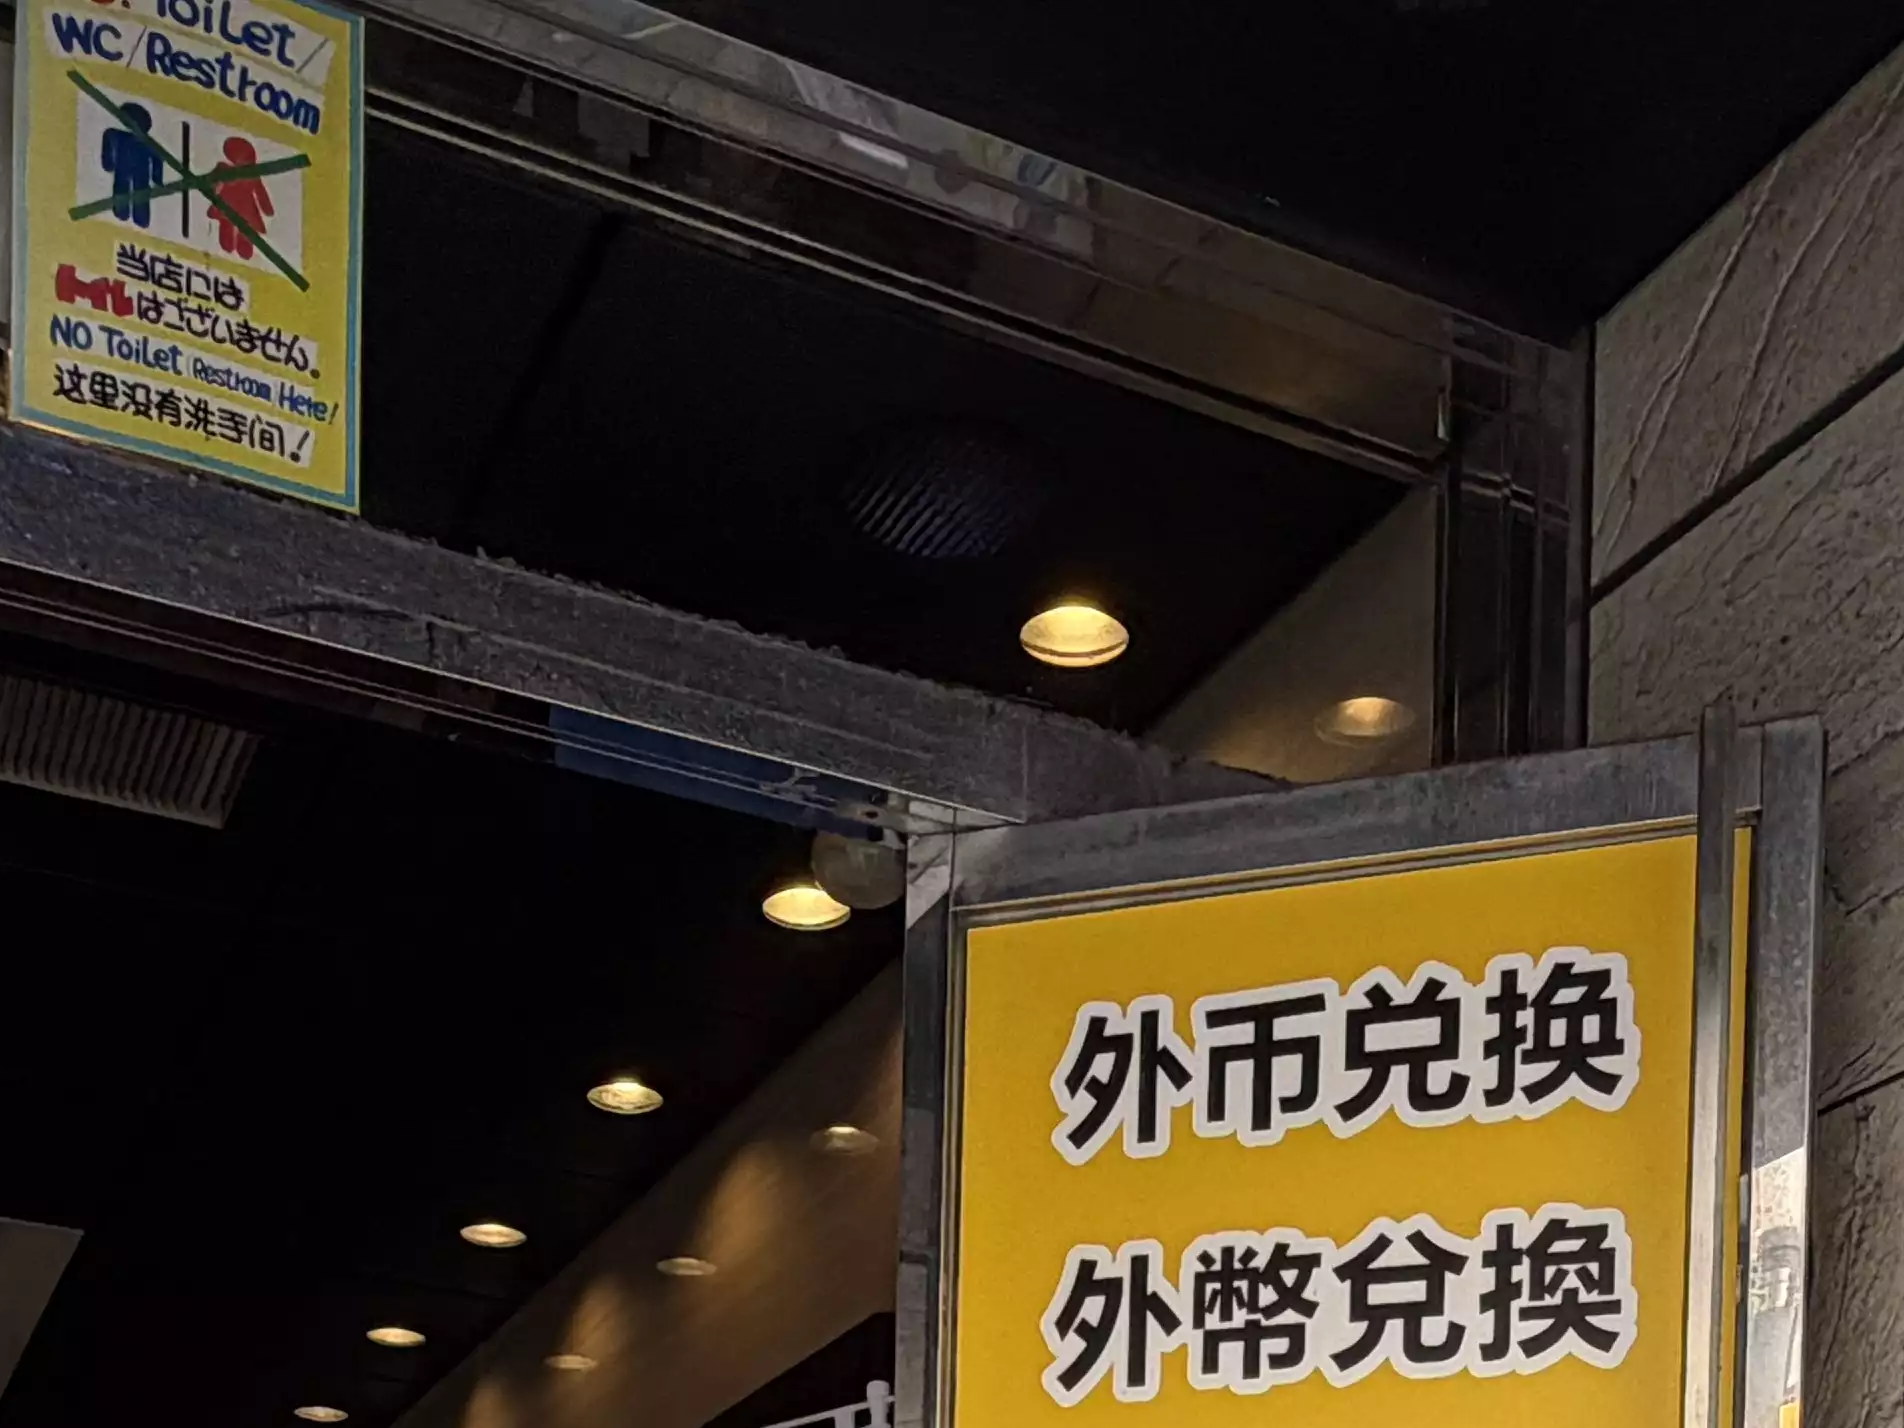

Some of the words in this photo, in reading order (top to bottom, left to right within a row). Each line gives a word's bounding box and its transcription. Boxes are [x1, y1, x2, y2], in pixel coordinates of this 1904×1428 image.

[116, 243, 245, 311] 当店には
[50, 313, 93, 351] NO
[192, 357, 271, 403] Restroom
[279, 378, 339, 426] Here!
[1064, 960, 1627, 1151] 外币兑换
[1055, 1218, 1623, 1393] 外幣兌換
